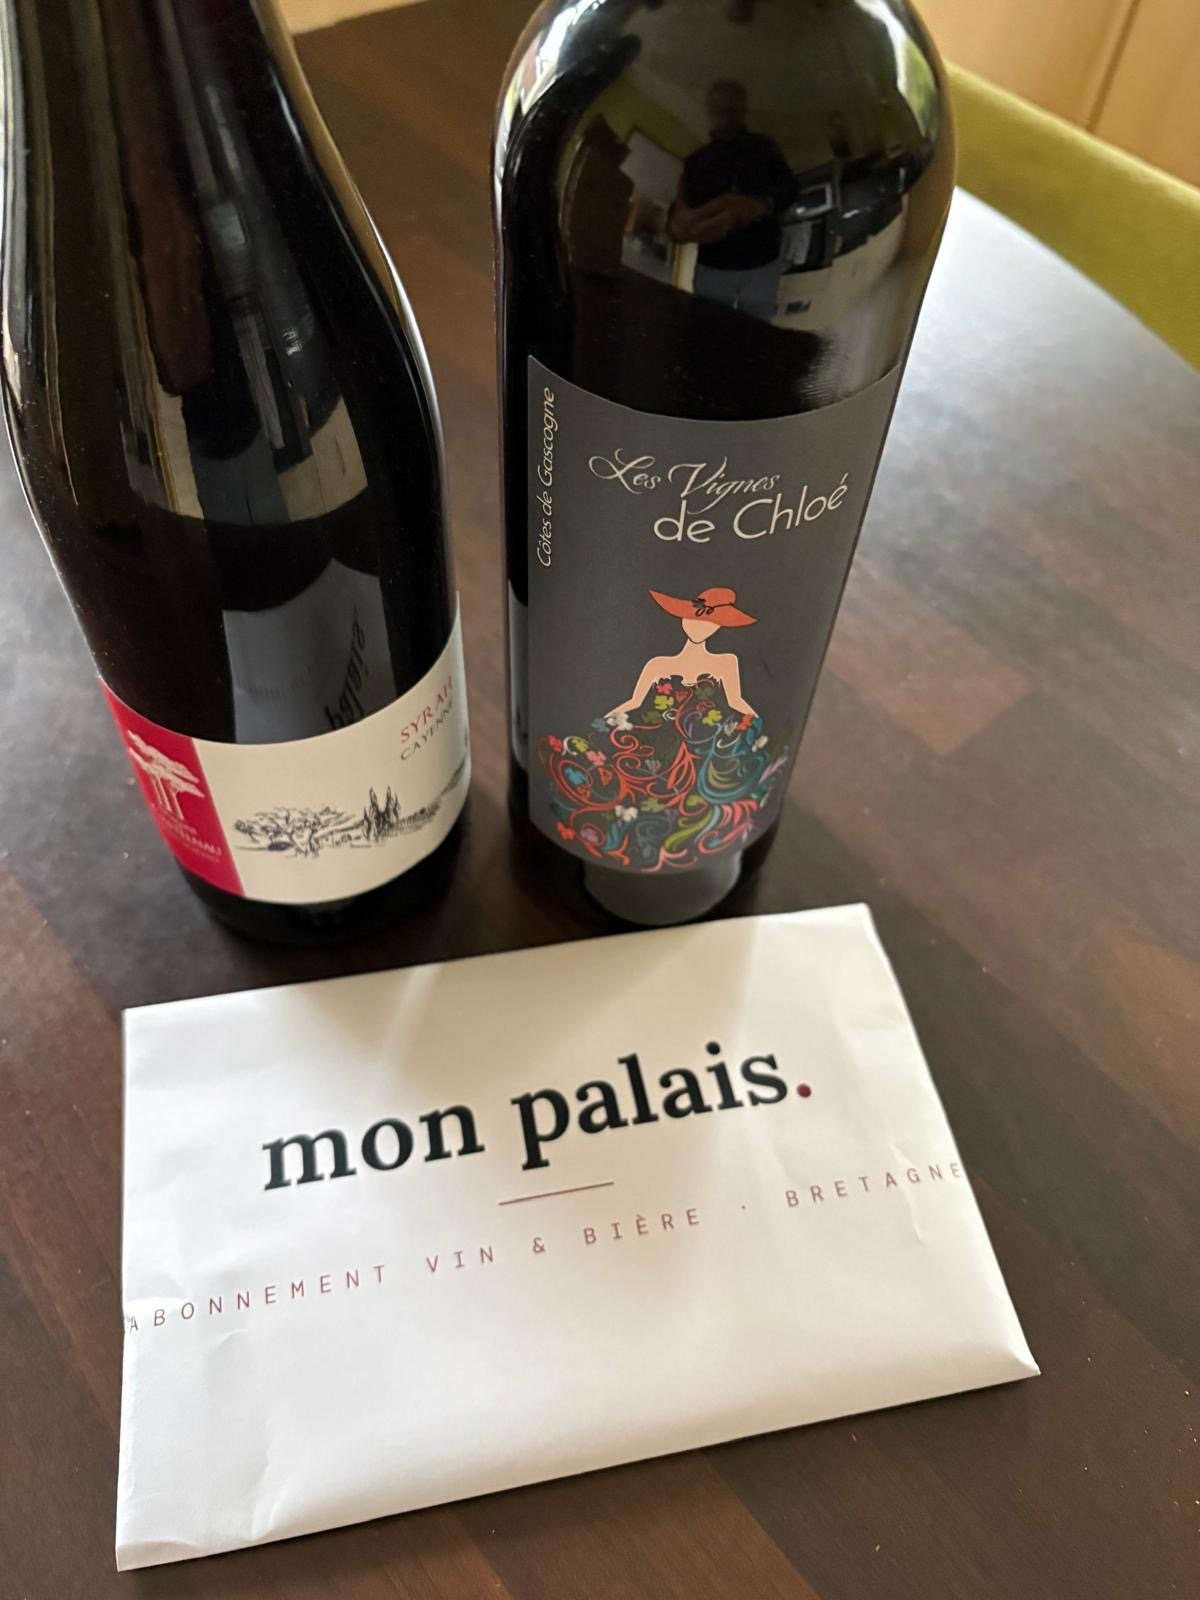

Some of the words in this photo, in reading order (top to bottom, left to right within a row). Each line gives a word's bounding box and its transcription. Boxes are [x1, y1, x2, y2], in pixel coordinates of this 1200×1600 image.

[537, 386, 559, 487] Gascogne
[536, 490, 553, 516] de
[588, 448, 661, 494] Les
[668, 456, 780, 514] Vignes
[653, 499, 716, 544] de
[733, 472, 849, 540] Chloé
[536, 515, 553, 567] Côtes
[262, 1104, 485, 1191] mon
[510, 1041, 813, 1171] palais.
[126, 1264, 385, 1334] ABONNEMENT
[425, 1245, 494, 1275] VIN
[531, 1236, 547, 1256] &
[583, 1207, 700, 1247] BIÈRE
[784, 1162, 962, 1209] BRETAGNE
